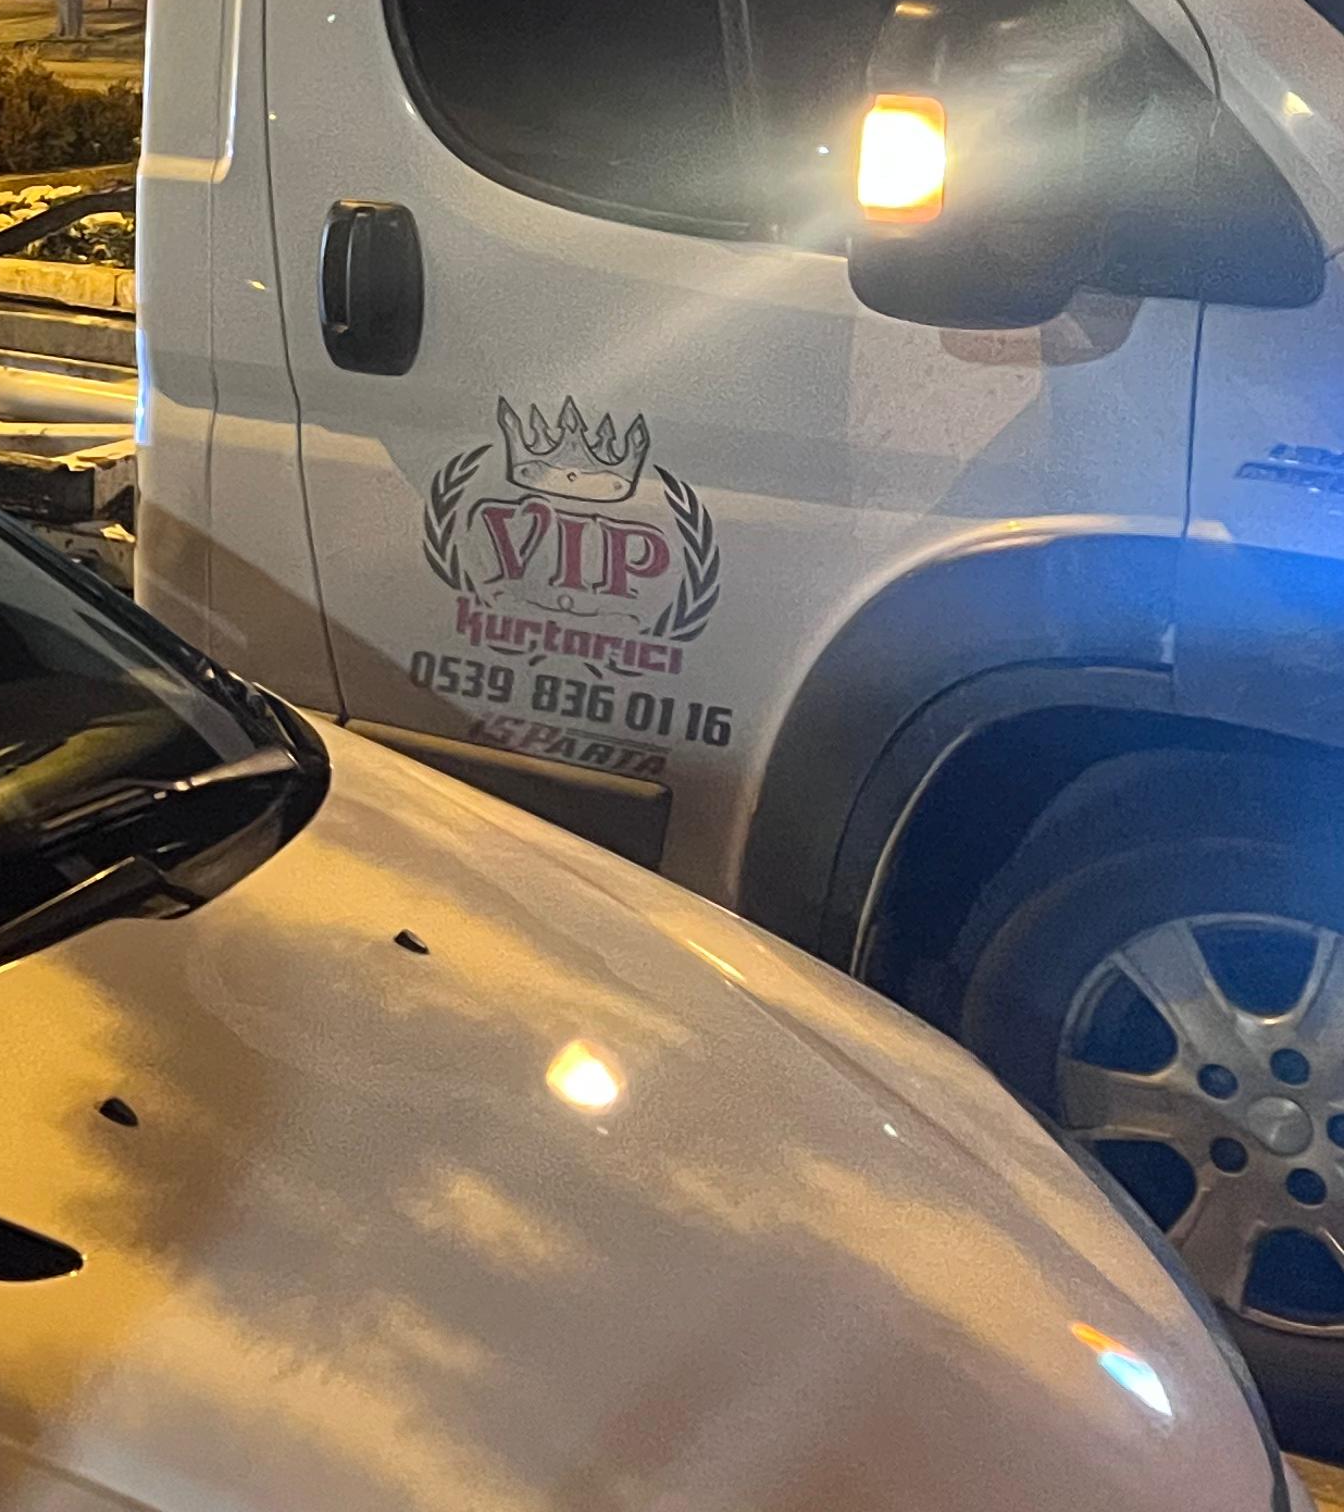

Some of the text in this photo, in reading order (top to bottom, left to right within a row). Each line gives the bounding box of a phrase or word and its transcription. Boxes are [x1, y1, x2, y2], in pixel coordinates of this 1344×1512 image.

[478, 498, 671, 600] VIP
[411, 650, 514, 703] 0539
[531, 674, 615, 724] 836
